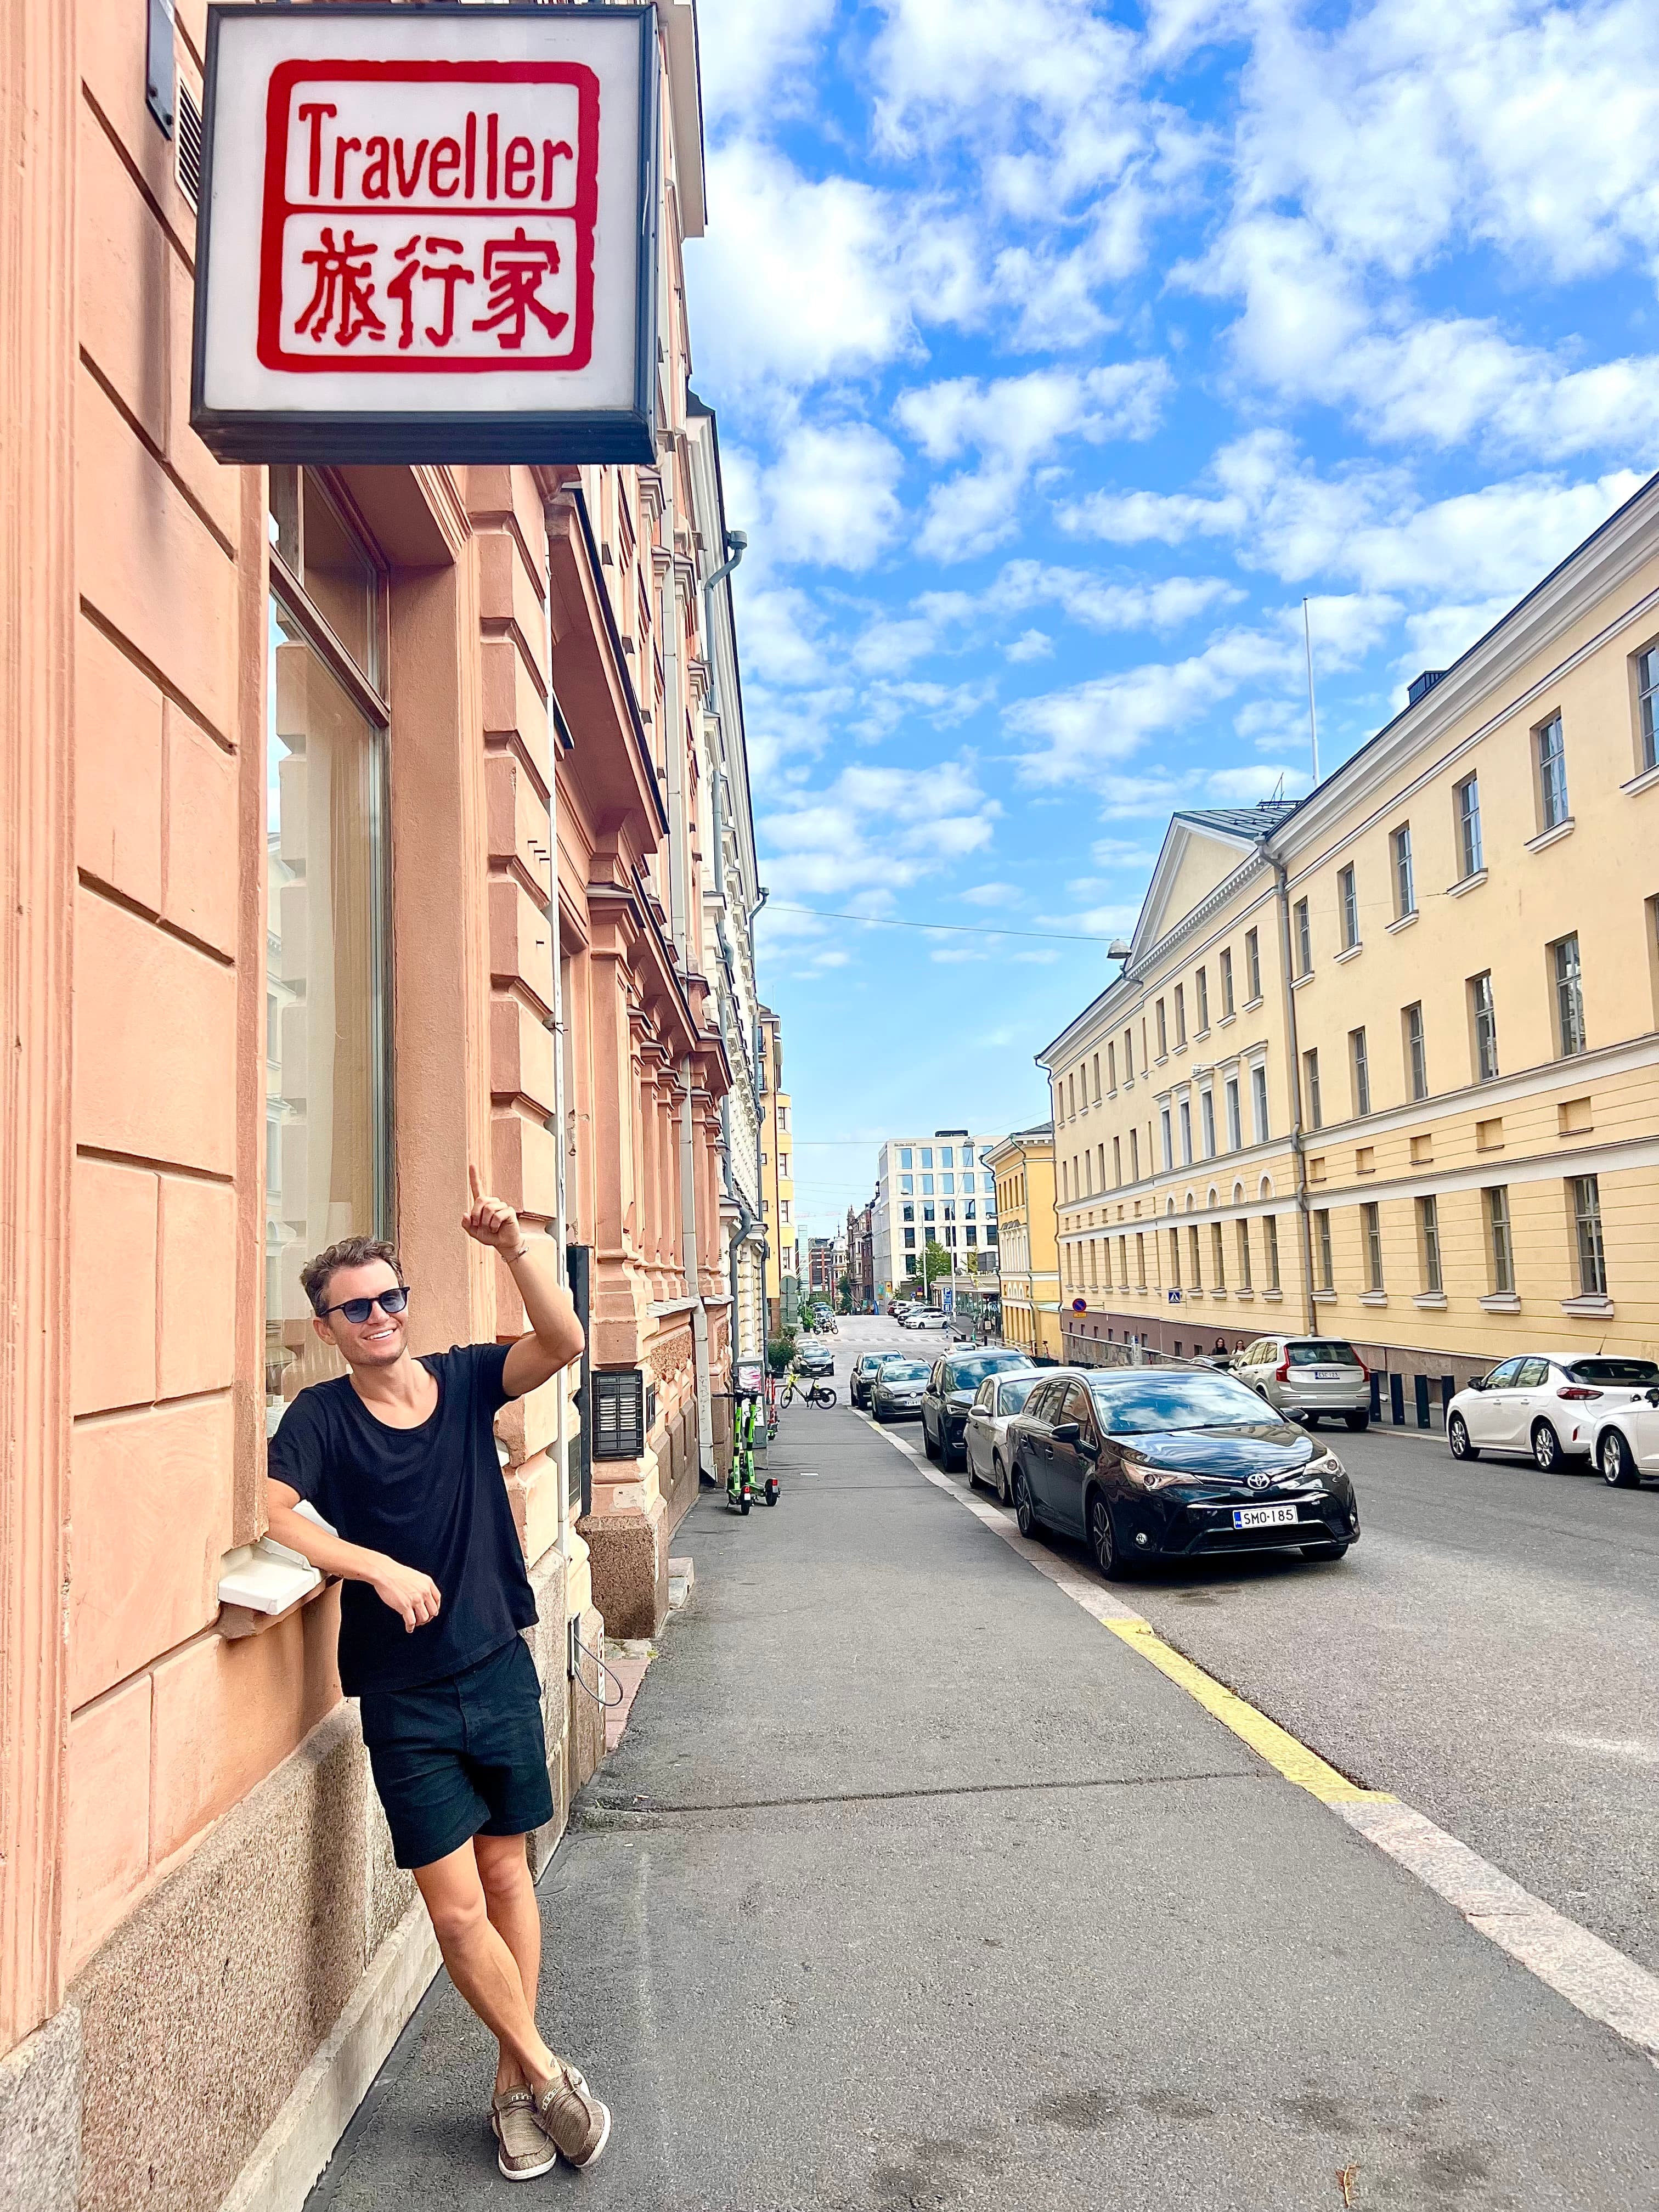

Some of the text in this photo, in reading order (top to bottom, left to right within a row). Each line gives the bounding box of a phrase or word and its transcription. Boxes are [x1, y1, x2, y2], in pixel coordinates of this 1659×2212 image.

[298, 103, 573, 201] Traveller
[294, 227, 570, 350] 旅行家
[1244, 1509, 1294, 1525] SMO-185
